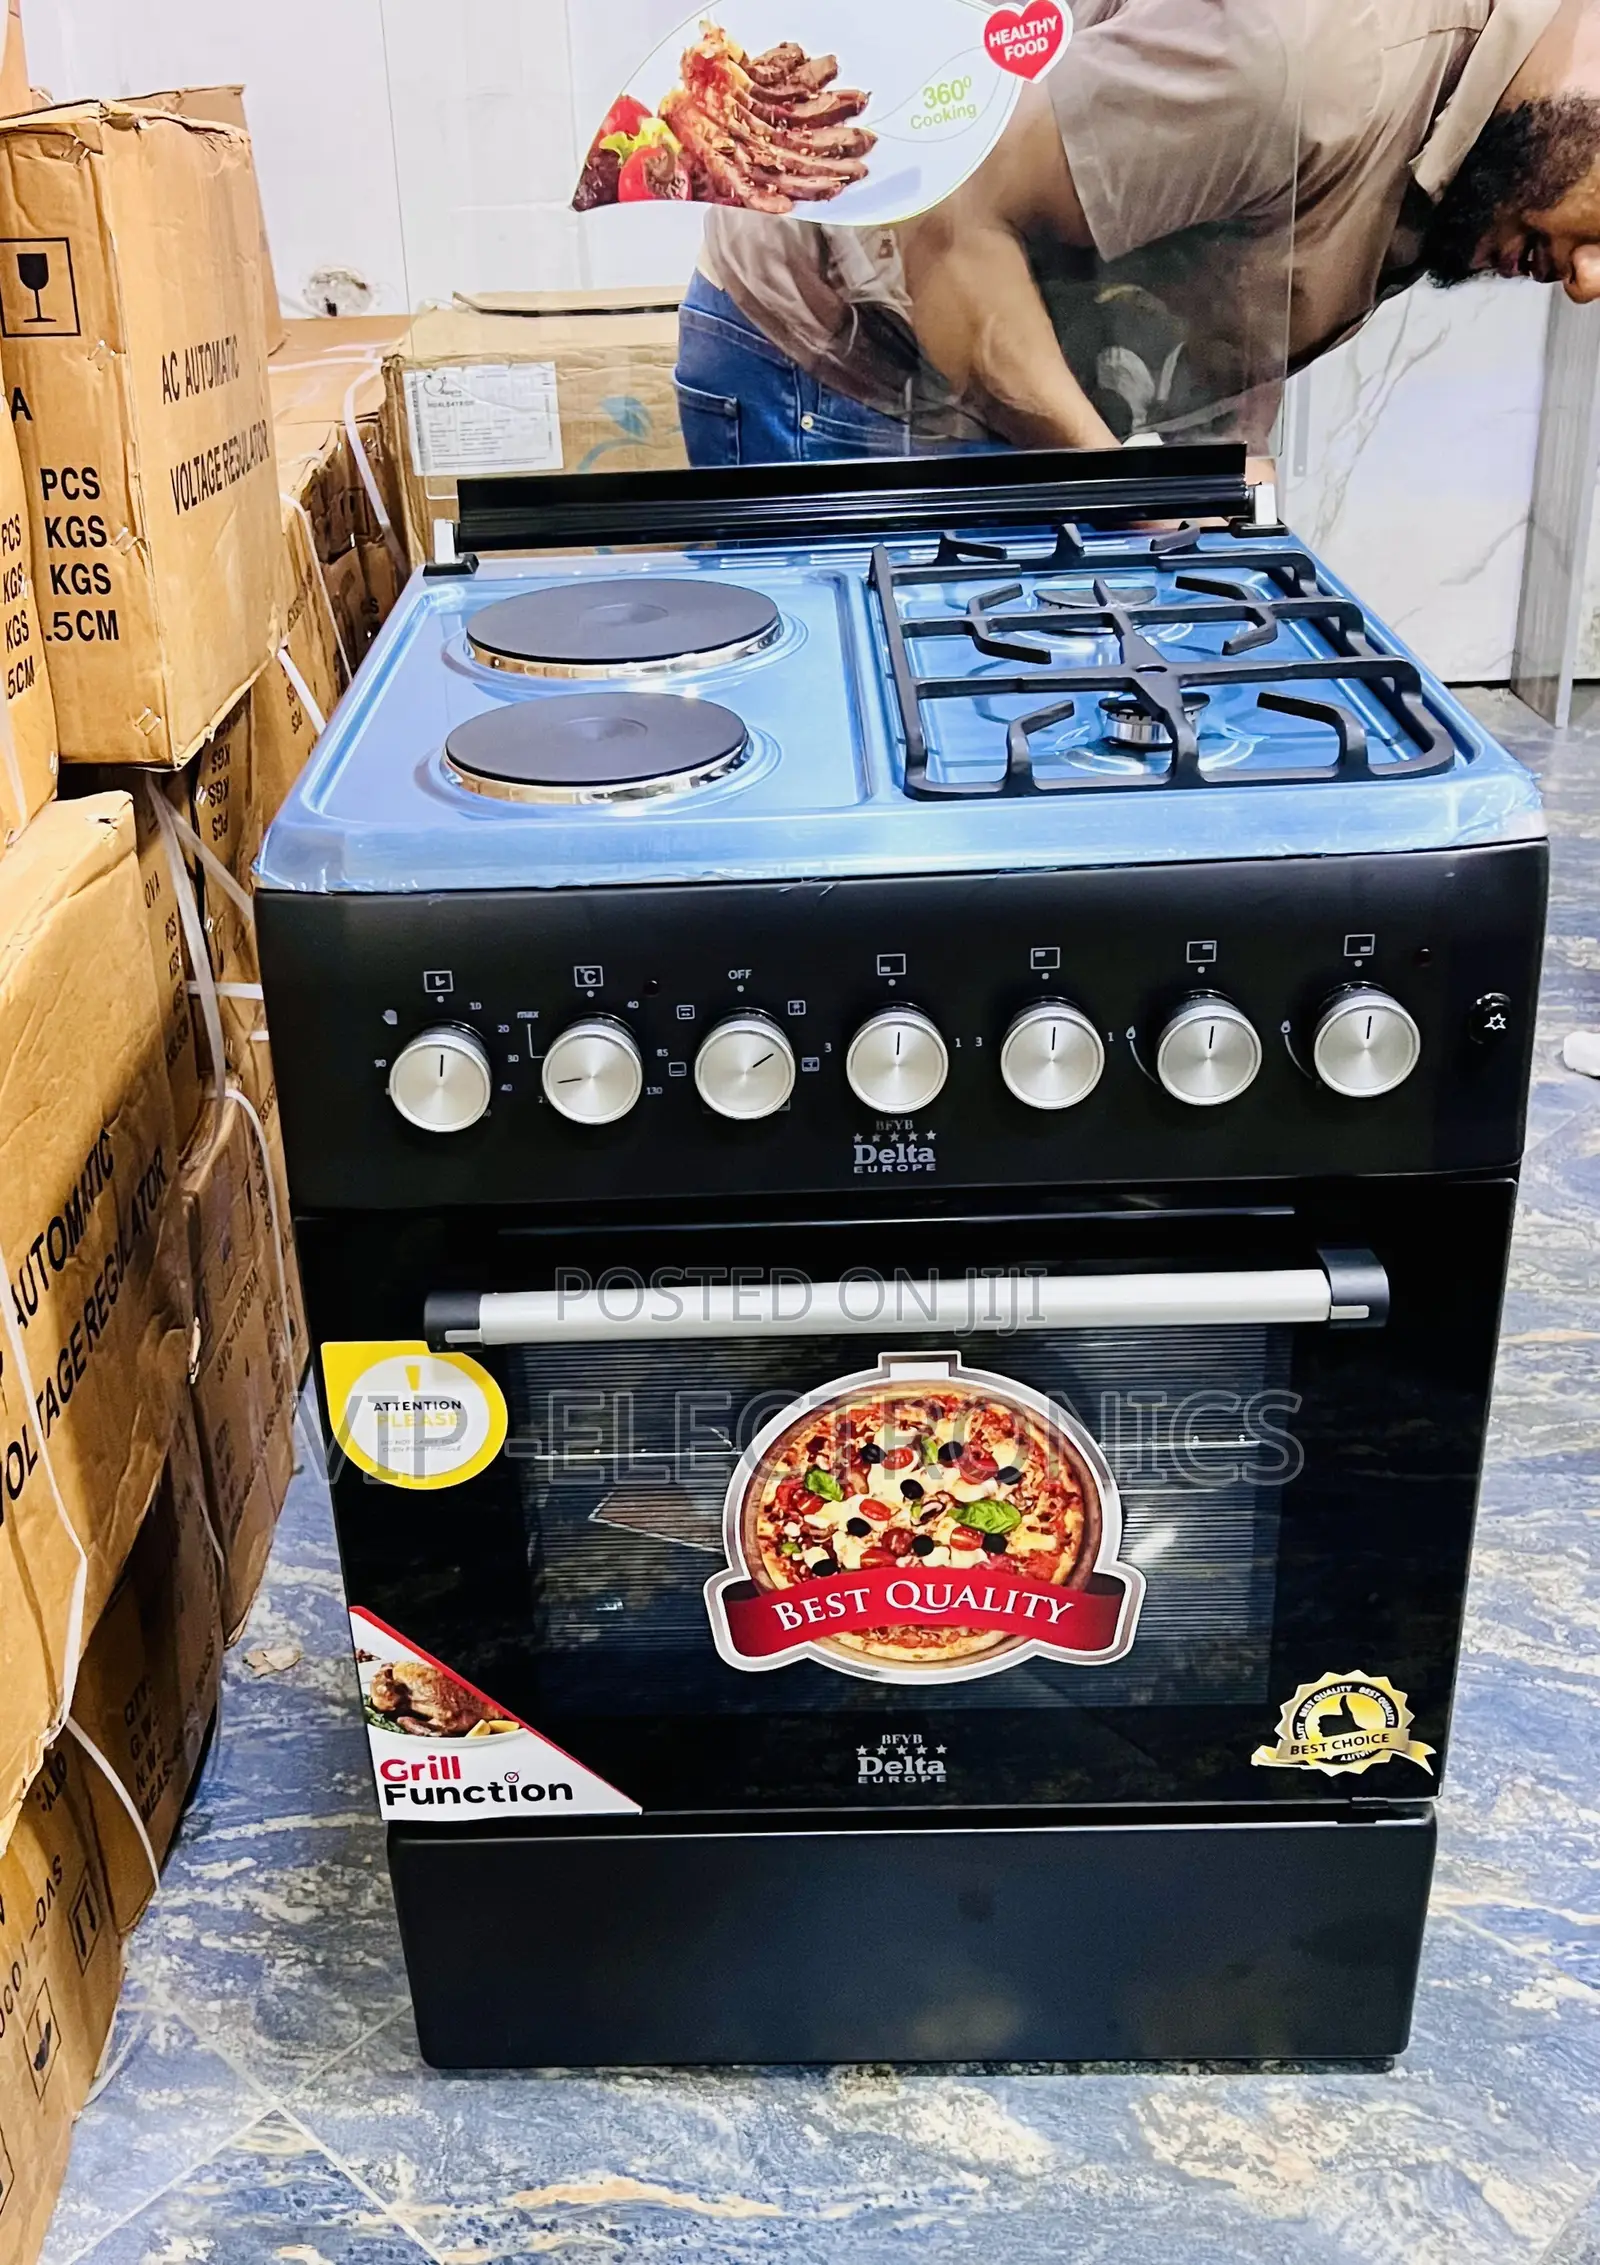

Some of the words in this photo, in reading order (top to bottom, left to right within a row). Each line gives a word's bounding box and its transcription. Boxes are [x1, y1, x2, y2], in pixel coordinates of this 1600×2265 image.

[988, 15, 1058, 48] HEALTHY
[1004, 37, 1049, 62] FOOD
[910, 103, 977, 130] Cooking
[162, 351, 180, 405] AC
[184, 334, 239, 397] AUTOMATIC
[40, 467, 101, 501] PCS
[170, 446, 222, 515] VOLTAGE
[2, 513, 21, 556] PCS
[44, 515, 107, 548] KGS
[3, 562, 24, 605] KGS
[50, 563, 112, 595] KGS
[5, 610, 29, 653] KGS
[45, 609, 119, 641] .5CM
[728, 969, 752, 980] OFF
[470, 1002, 482, 1011] 10
[516, 1011, 539, 1019] max
[627, 1001, 640, 1010] 40
[498, 1025, 510, 1033] 20
[825, 1042, 832, 1053] 3
[975, 1037, 982, 1047] 3
[374, 1059, 387, 1068] 90
[507, 1055, 519, 1063] 30
[500, 1084, 513, 1092] 40
[646, 1086, 663, 1095] 130
[853, 1143, 936, 1165] Delta
[853, 1163, 936, 1174] EUROPE
[374, 1401, 462, 1411] ATTENTION
[0, 1321, 87, 1527] OLTAGE
[377, 1411, 460, 1428] PLEASE
[771, 1588, 870, 1632] BEST
[885, 1579, 1075, 1625] QUALITY
[1313, 1685, 1352, 1702] QUALITY
[1359, 1686, 1381, 1699] BEST
[882, 1733, 923, 1745] BFYB
[1290, 1742, 1327, 1756] BEST
[1331, 1733, 1390, 1750] CHOICE
[380, 1755, 461, 1782] Grill
[857, 1756, 947, 1775] Delta
[384, 1772, 573, 1806] Function
[858, 1775, 947, 1784] EUROPE
